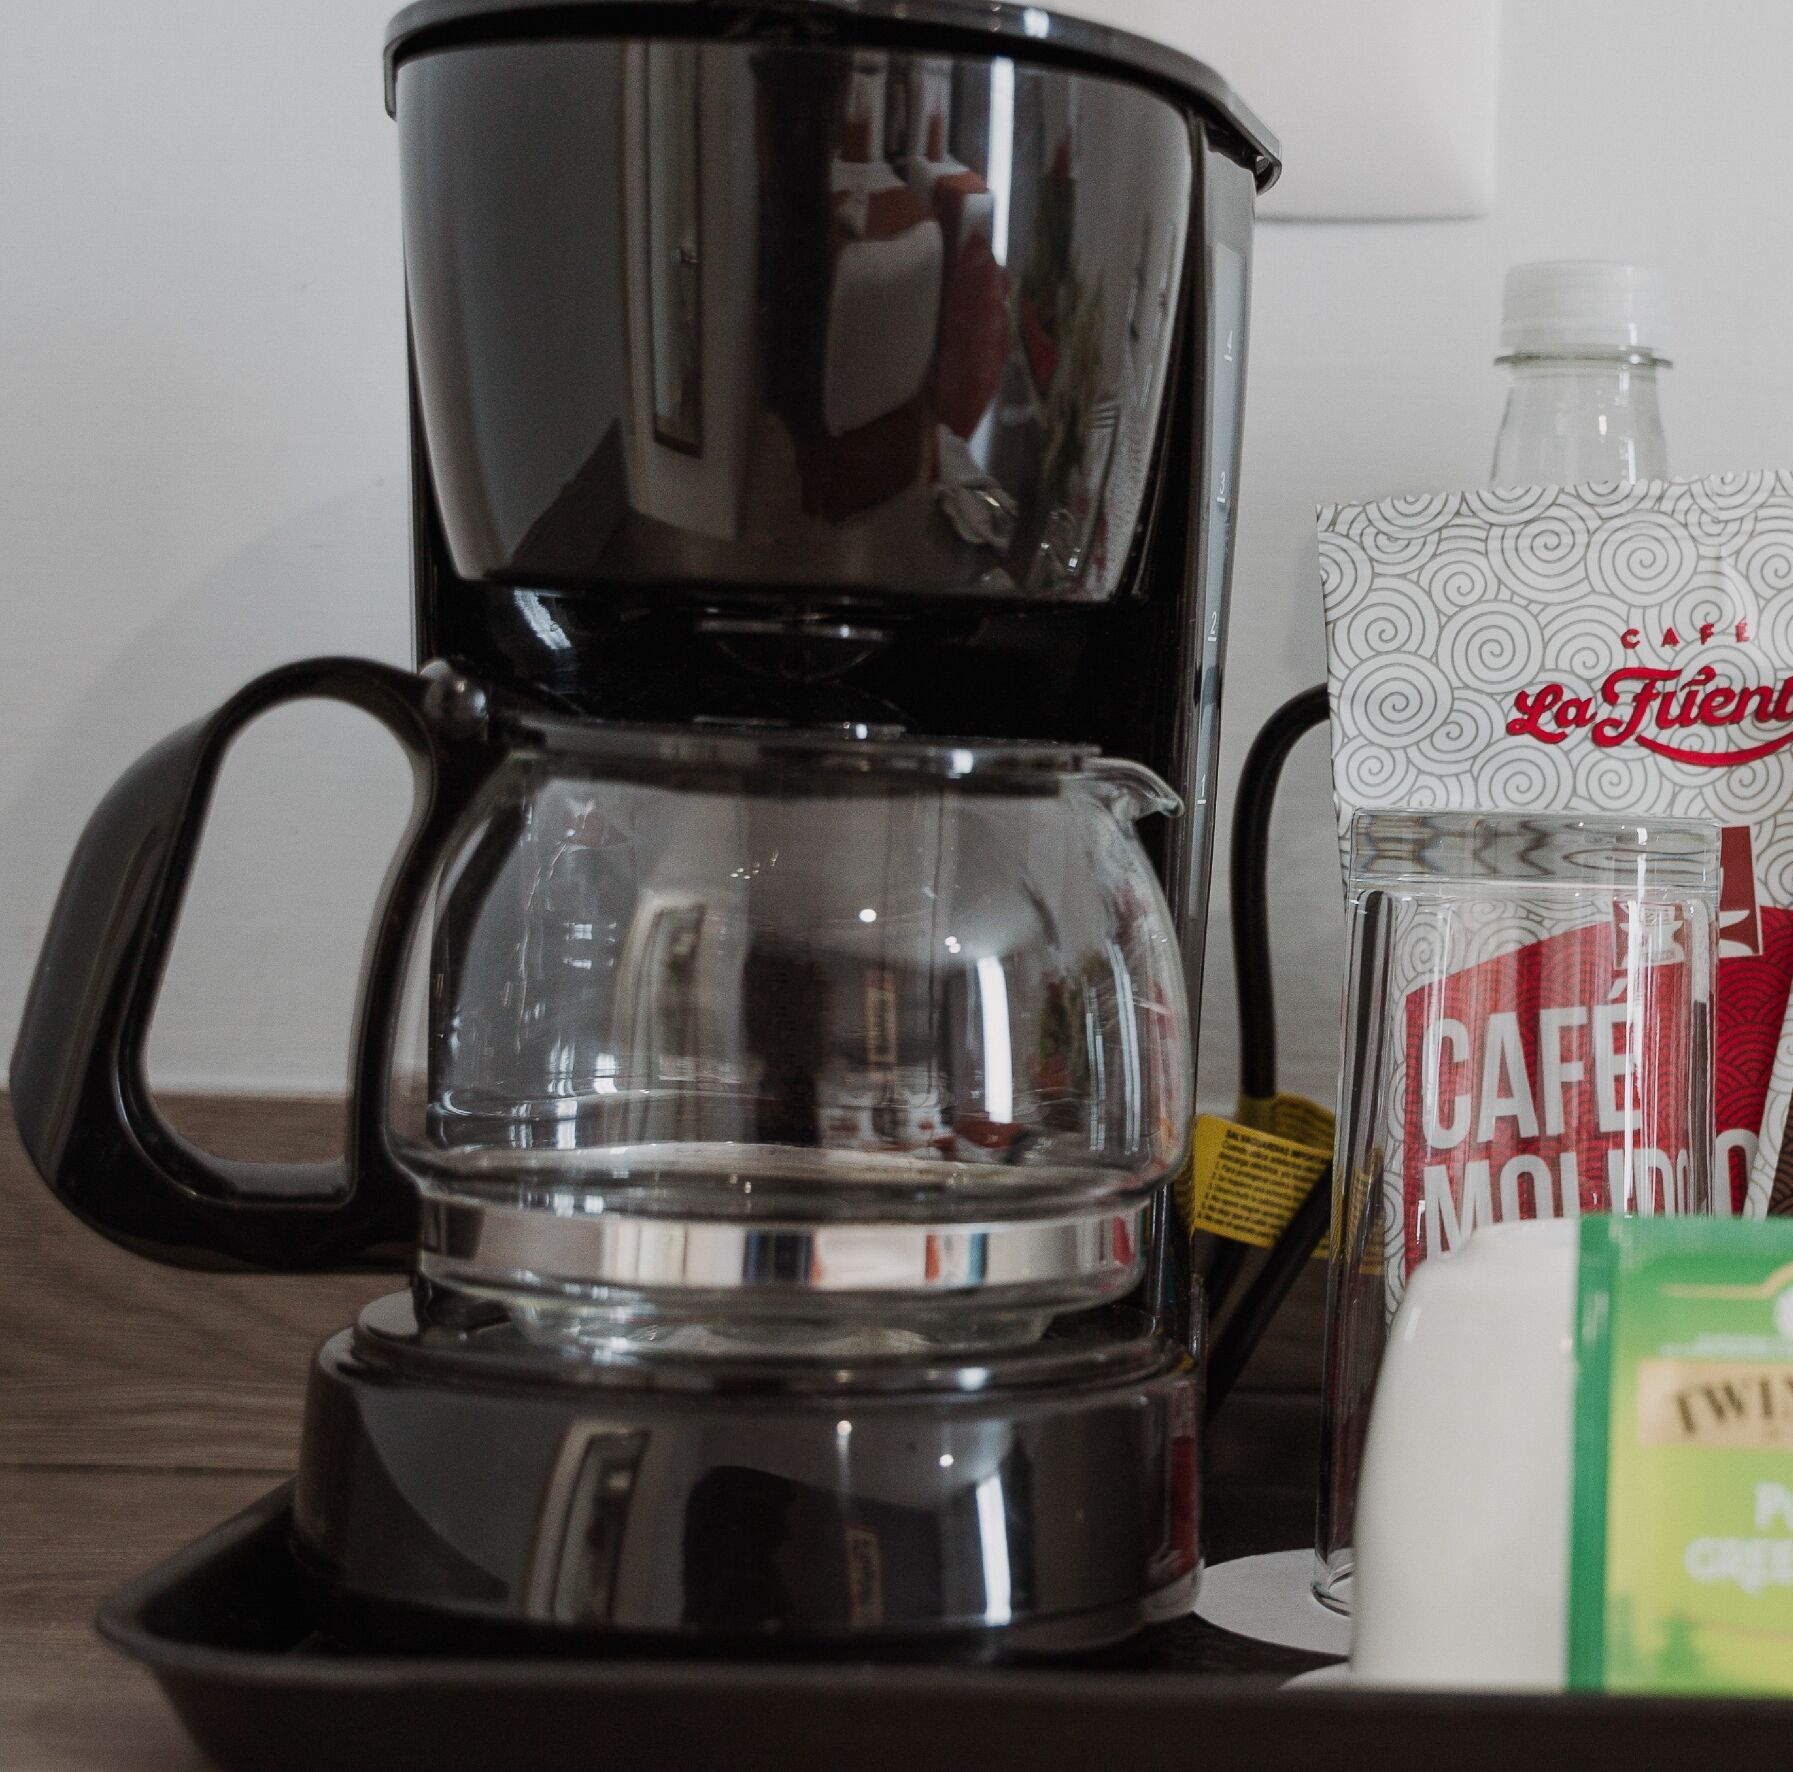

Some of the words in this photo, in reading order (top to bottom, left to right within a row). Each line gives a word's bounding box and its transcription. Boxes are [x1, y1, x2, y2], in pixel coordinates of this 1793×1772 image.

[1219, 471, 1226, 494] 3
[1210, 611, 1217, 635] 2
[1620, 617, 1751, 650] CAFÉ
[1506, 683, 1597, 745] La
[1421, 978, 1641, 1149] CAFÉ
